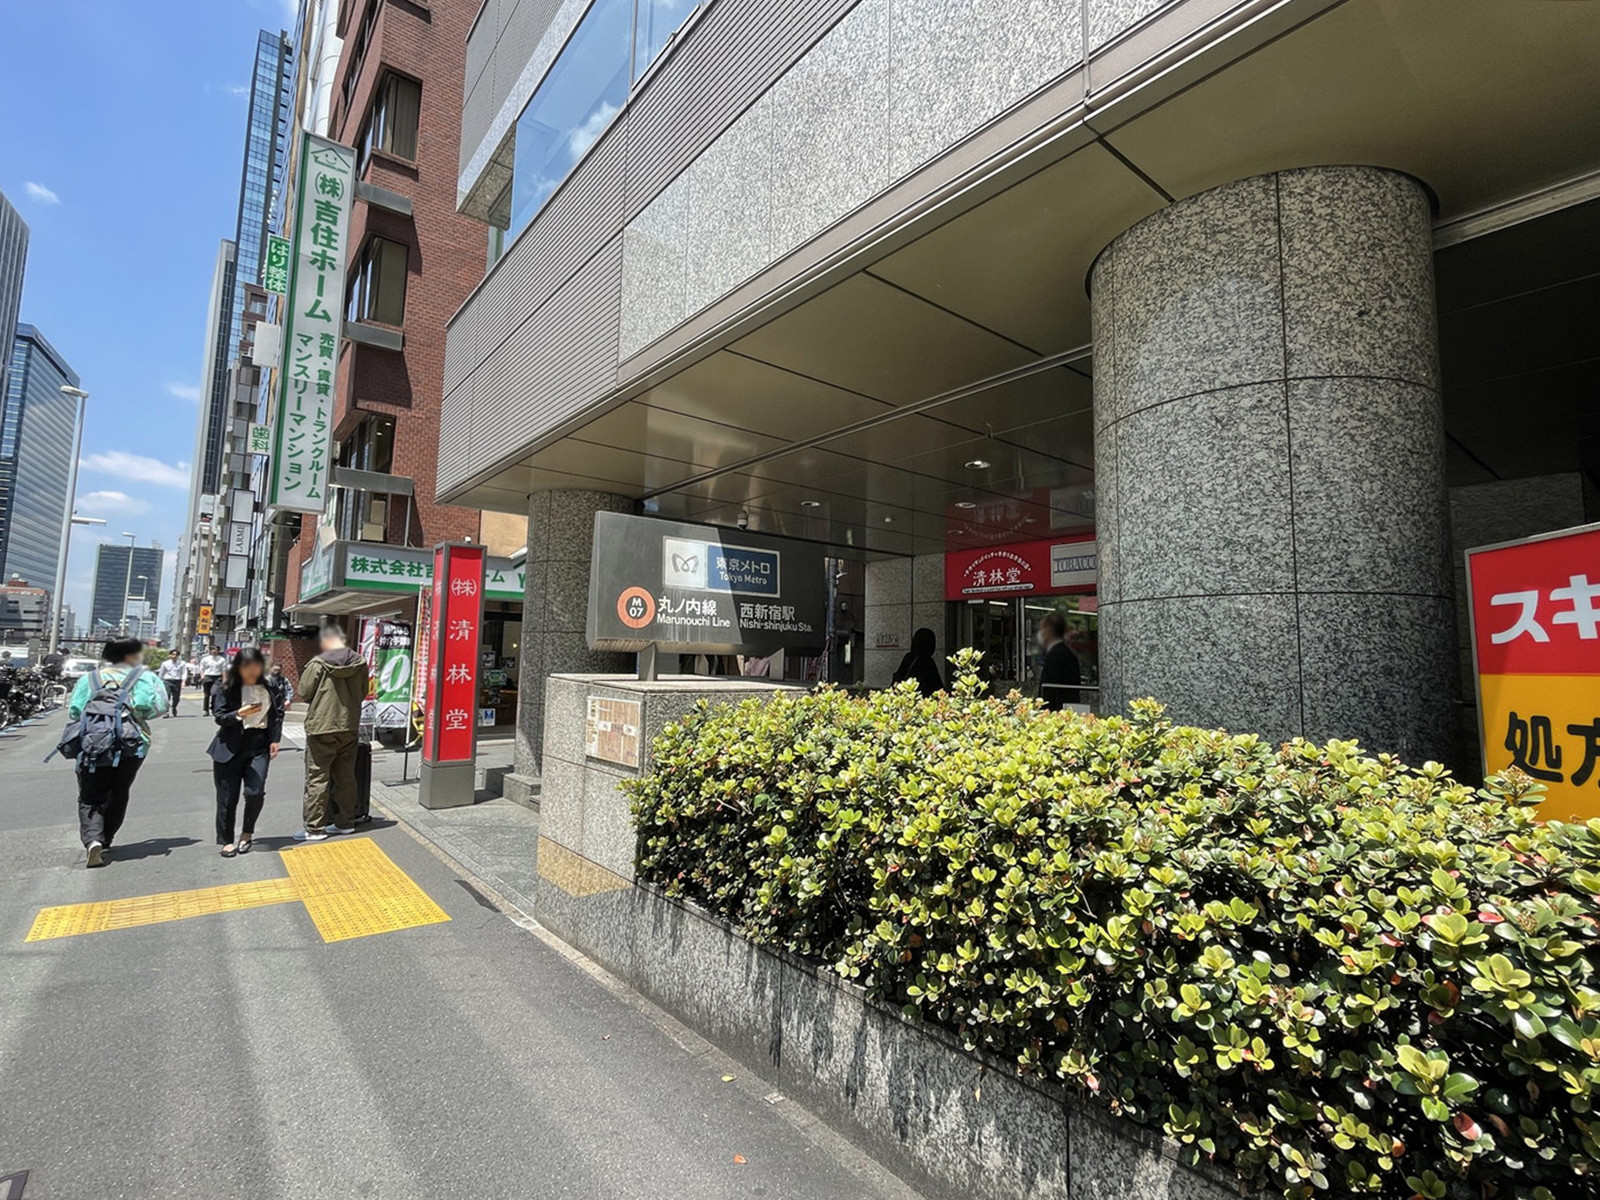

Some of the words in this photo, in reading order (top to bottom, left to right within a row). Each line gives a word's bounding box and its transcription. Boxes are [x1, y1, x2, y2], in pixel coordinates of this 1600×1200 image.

[284, 333, 313, 491] マンスリーマンション
[252, 425, 270, 452] 歯科
[716, 557, 770, 575] 東京メトロ
[719, 571, 743, 583] Tokyo
[744, 574, 767, 585] Metro
[973, 567, 1020, 586] 清林堂
[632, 598, 642, 607] M
[658, 596, 717, 616] 丸ノ内線
[740, 602, 796, 621] 西新宿駅
[629, 607, 644, 618] 07
[657, 613, 711, 627] Marunouchi
[712, 617, 731, 628] Line
[740, 618, 798, 633] Nishi-shinjuku
[798, 622, 813, 633] Sta.
